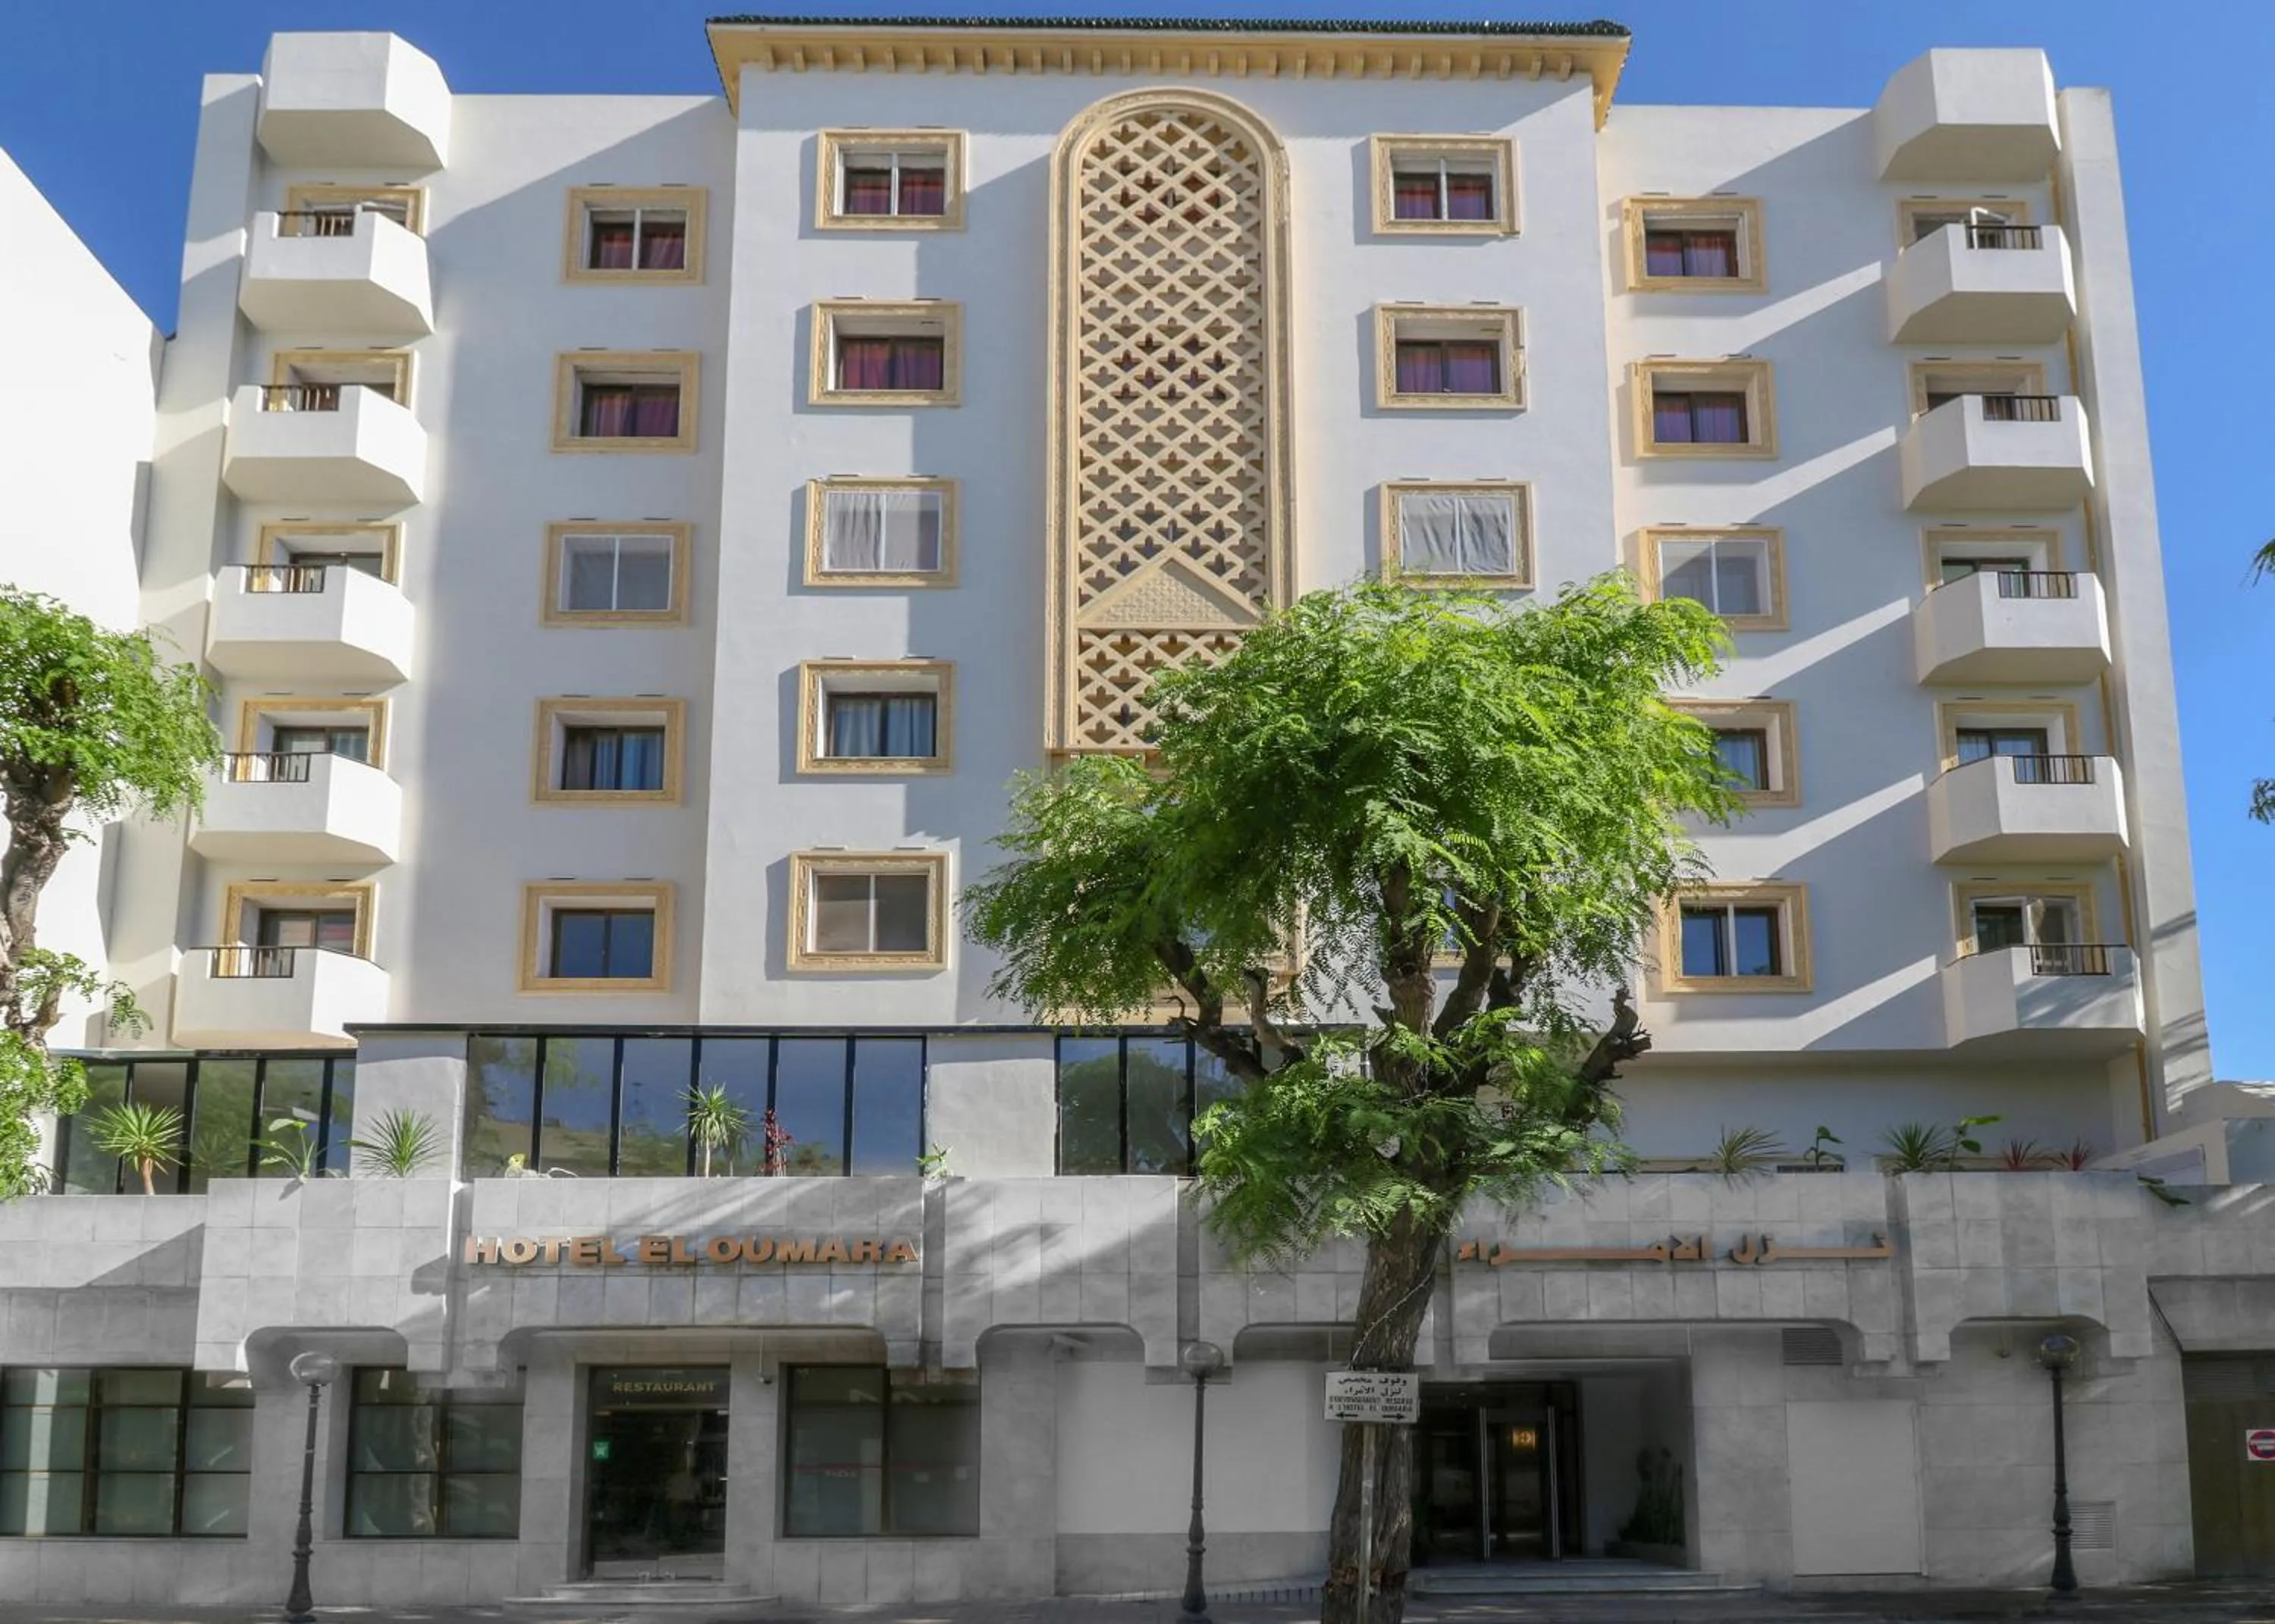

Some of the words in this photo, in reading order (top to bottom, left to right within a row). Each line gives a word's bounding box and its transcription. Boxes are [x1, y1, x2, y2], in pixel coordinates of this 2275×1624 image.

[464, 1236, 626, 1265] HOTEL
[639, 1235, 697, 1264] EL
[707, 1235, 919, 1264] OUMARA
[613, 1381, 715, 1393] RESTAURANT
